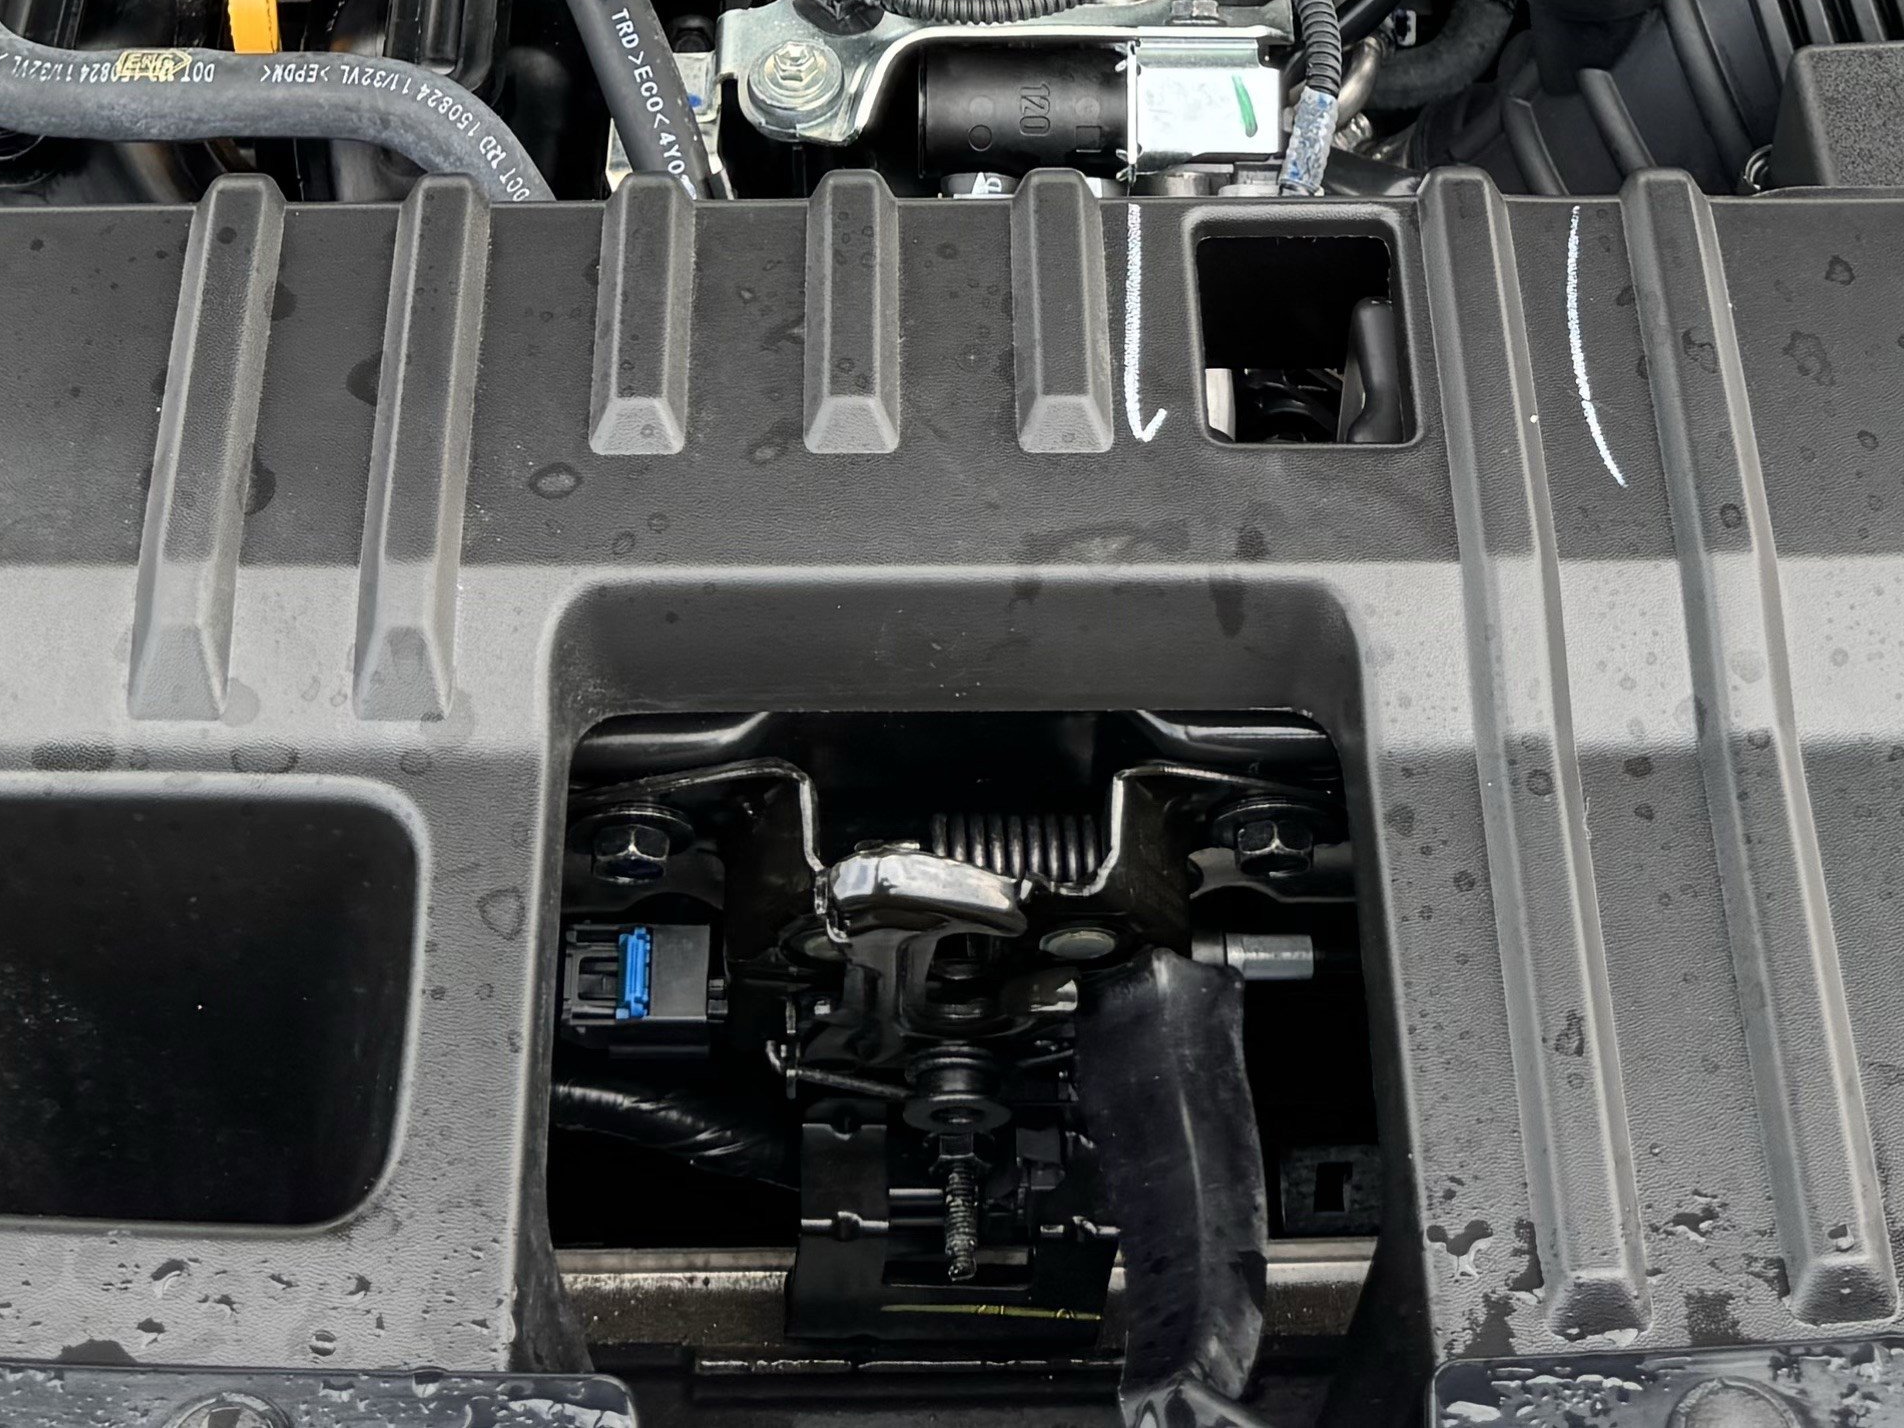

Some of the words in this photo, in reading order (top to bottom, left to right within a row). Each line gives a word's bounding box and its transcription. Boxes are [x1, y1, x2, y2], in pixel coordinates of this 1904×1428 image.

[180, 62, 215, 83] DOT
[416, 83, 481, 137] 150824
[1019, 83, 1051, 137] 120
[499, 167, 531, 202] DOT
